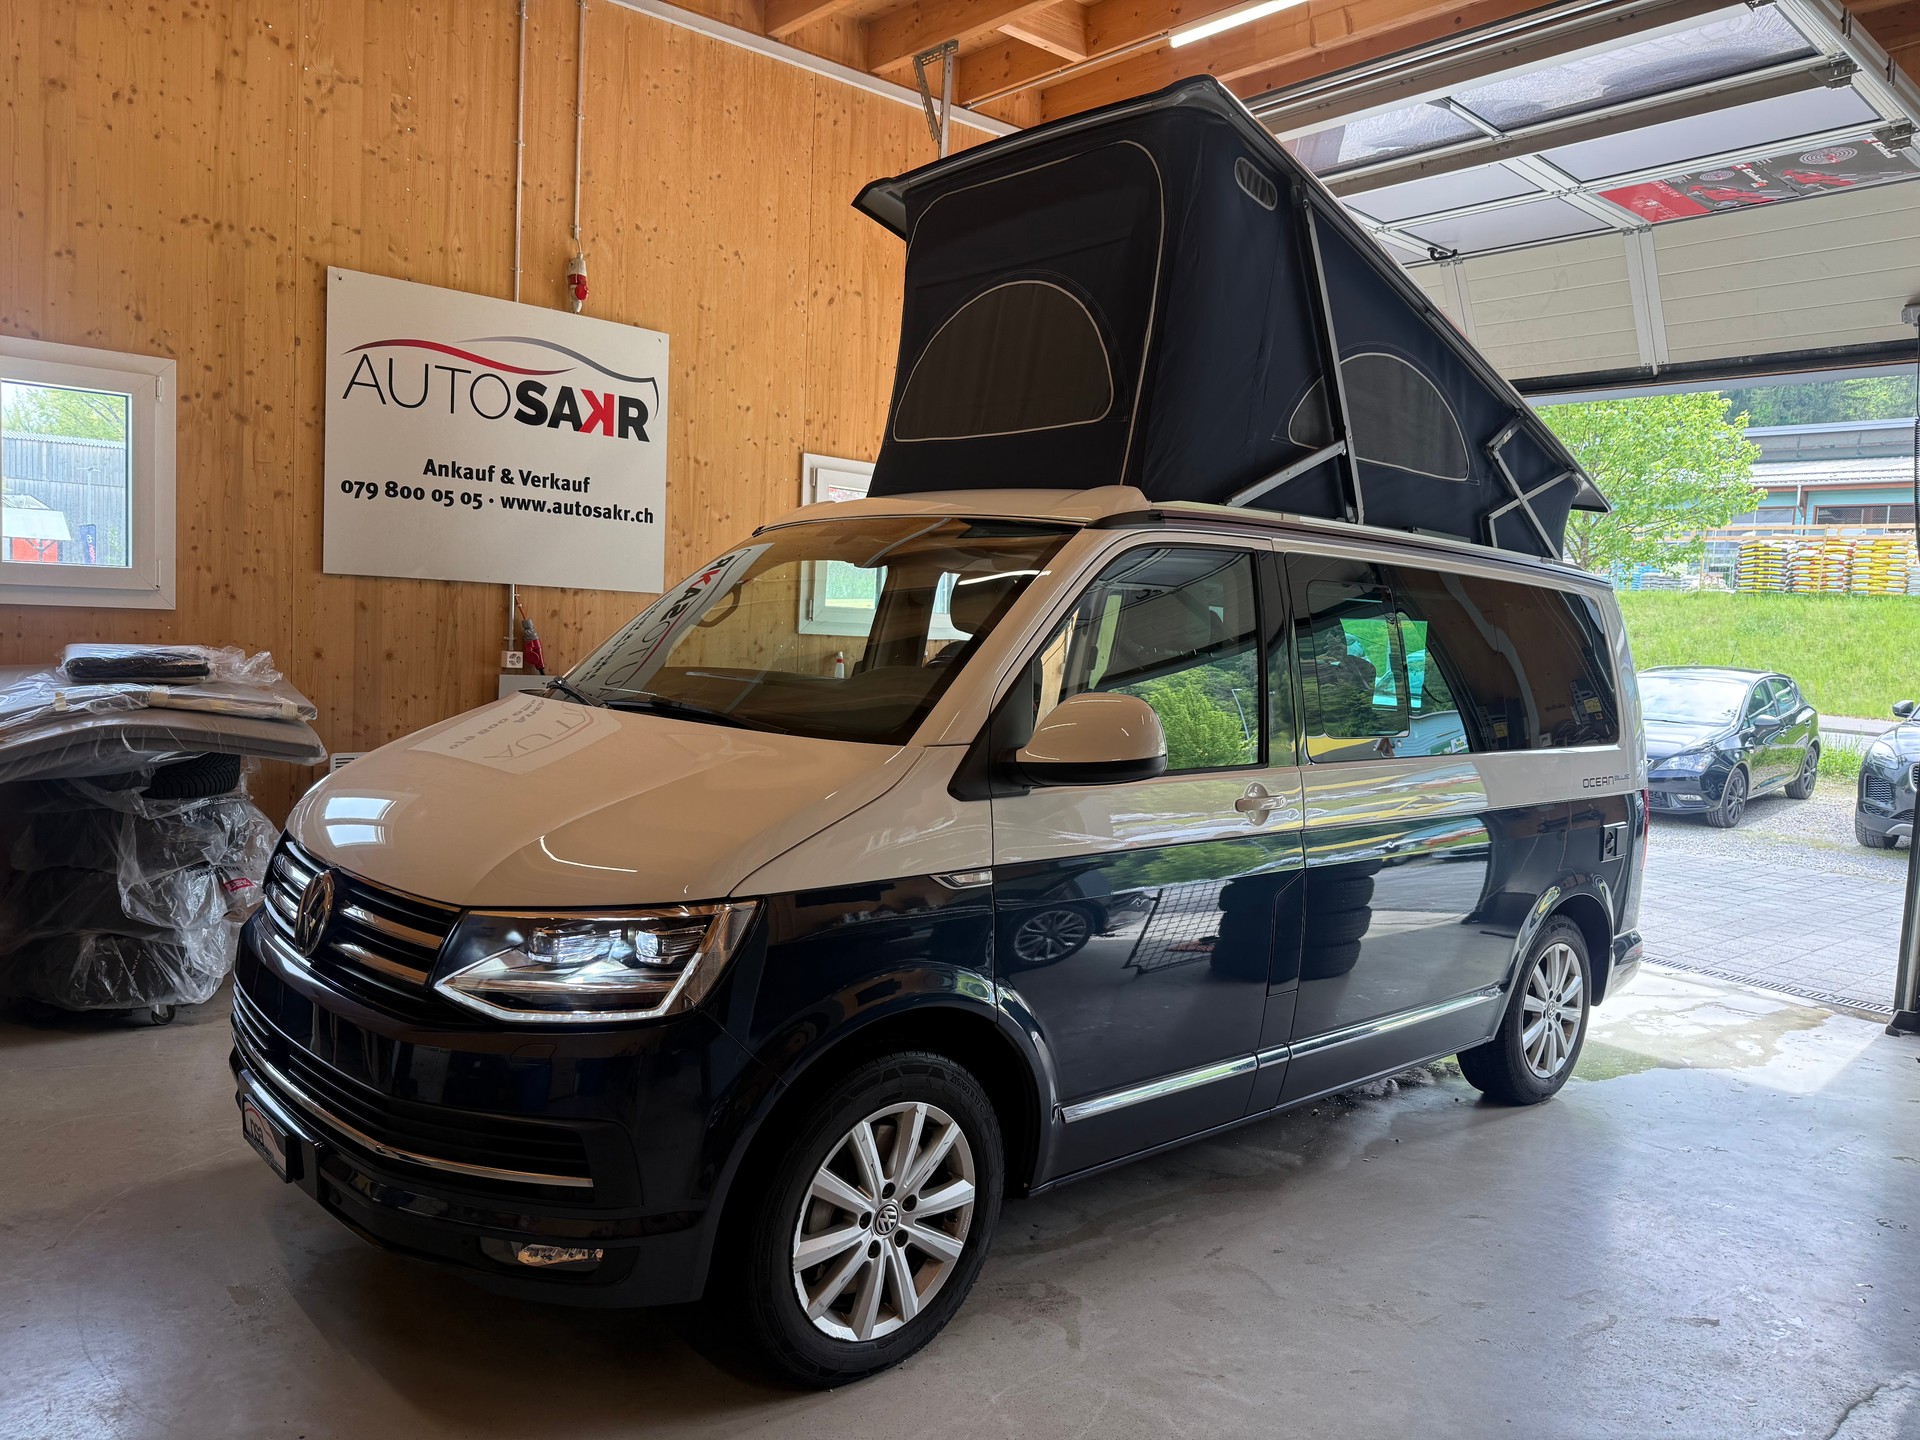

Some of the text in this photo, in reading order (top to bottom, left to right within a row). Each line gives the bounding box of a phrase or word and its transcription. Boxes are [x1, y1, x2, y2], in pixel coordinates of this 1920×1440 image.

[342, 353, 650, 442] AUTOSAKR
[423, 459, 590, 493] Ankauf & Verkauf
[341, 479, 654, 524] 079 800 05 05 www.autosakr.ch
